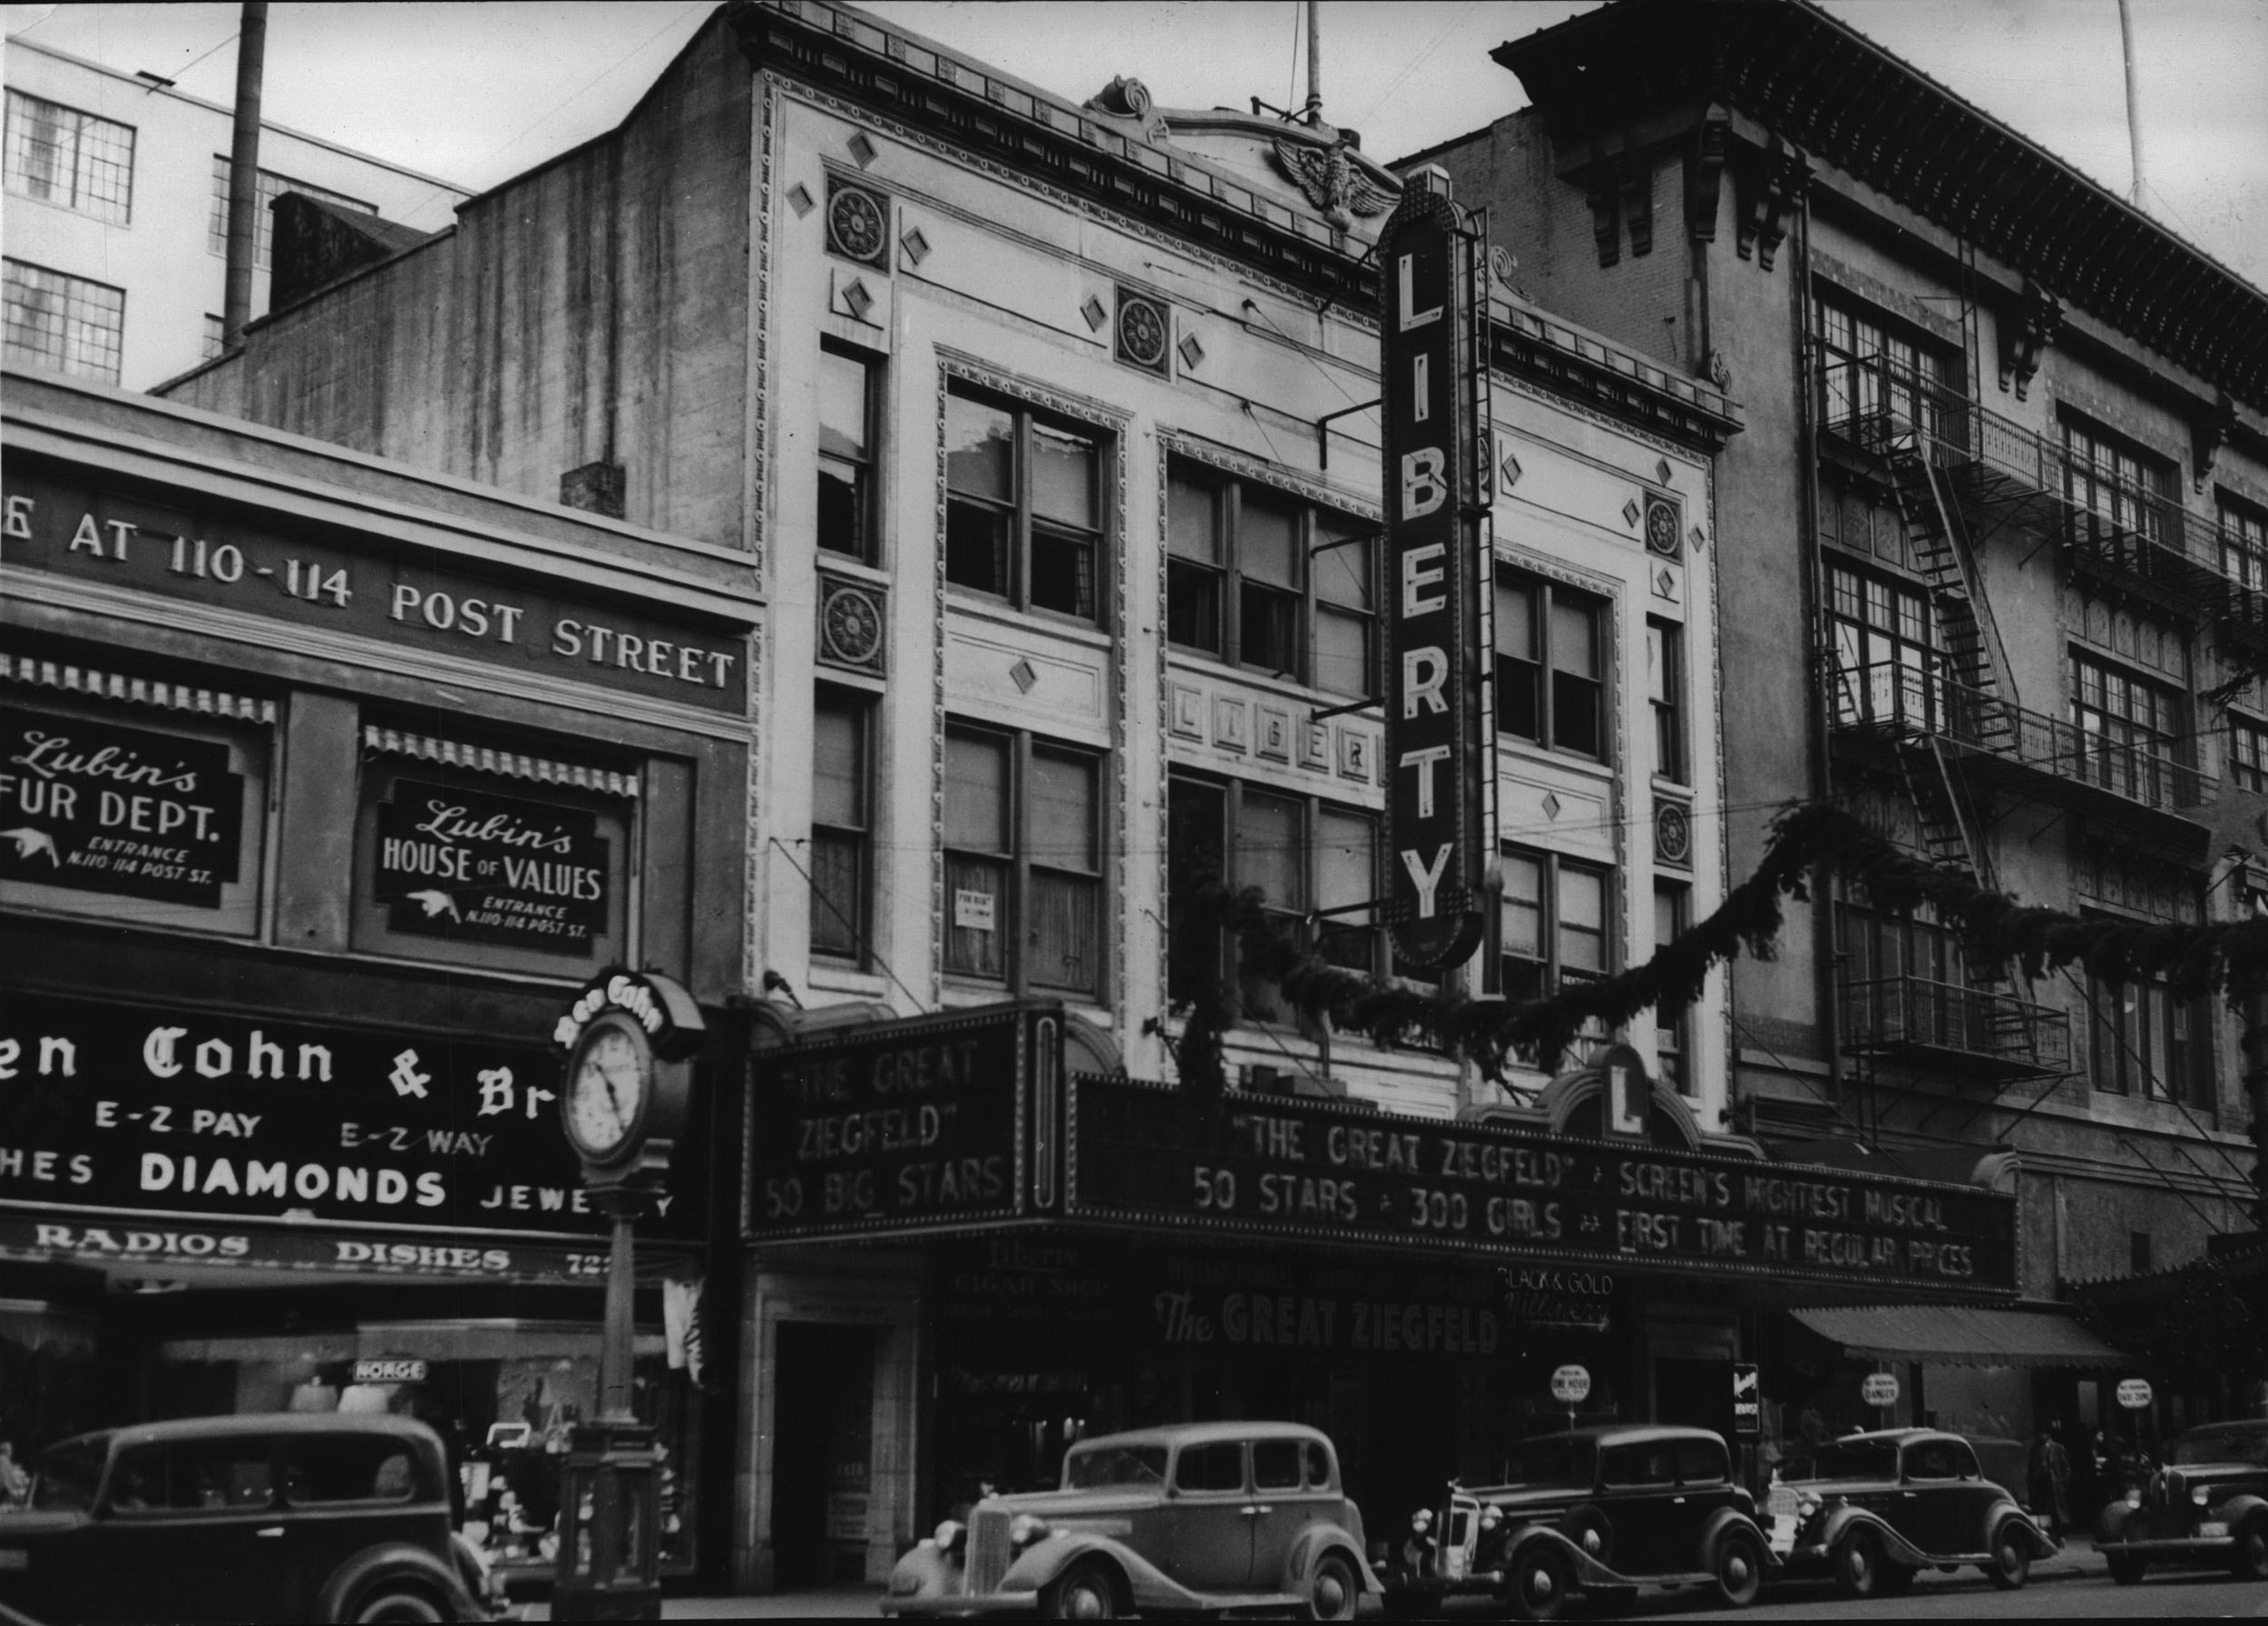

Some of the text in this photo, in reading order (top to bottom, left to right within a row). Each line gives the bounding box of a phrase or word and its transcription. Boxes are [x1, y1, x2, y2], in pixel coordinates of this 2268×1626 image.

[4, 495, 736, 689] E AT 110-114 POST STREET
[1398, 252, 1453, 919] LIBERTY
[10, 730, 198, 792] Lubin's
[99, 790, 220, 843] DEPT.
[415, 798, 572, 854] Lubin's
[87, 836, 191, 863] ENTRANCE
[141, 862, 187, 879] POST
[188, 868, 214, 885] ST.
[382, 837, 601, 902] HOUSE OF VALUES
[482, 895, 568, 920] ENTRANCE
[527, 918, 565, 935] POST
[566, 924, 587, 938] ST.
[607, 984, 664, 1034] Cohn
[0, 1025, 557, 1120] en Cohn & Br
[872, 1038, 979, 1094] GREAT
[94, 1100, 263, 1139] E-Z PAY
[1610, 1064, 1643, 1134] L
[339, 1122, 495, 1157] E-Z WAY
[1327, 1125, 1422, 1175] GREAT
[0, 1147, 674, 1219] HES DIAMONDS JEWEY
[766, 1154, 1003, 1220] 50 BIG STARS
[1619, 1161, 1731, 1207] SCREEN'S
[1864, 1189, 1949, 1232] MUSICAL
[35, 1223, 250, 1258] RADIOS
[1194, 1164, 1975, 1278] 50 STARS 300 GIRLS FIRST TIME AT REGULAR PRICES
[336, 1239, 613, 1275] DISHES 72
[1568, 1271, 1614, 1296] GOLD
[1154, 1288, 1500, 1355] The GREAT ZIEGFELD
